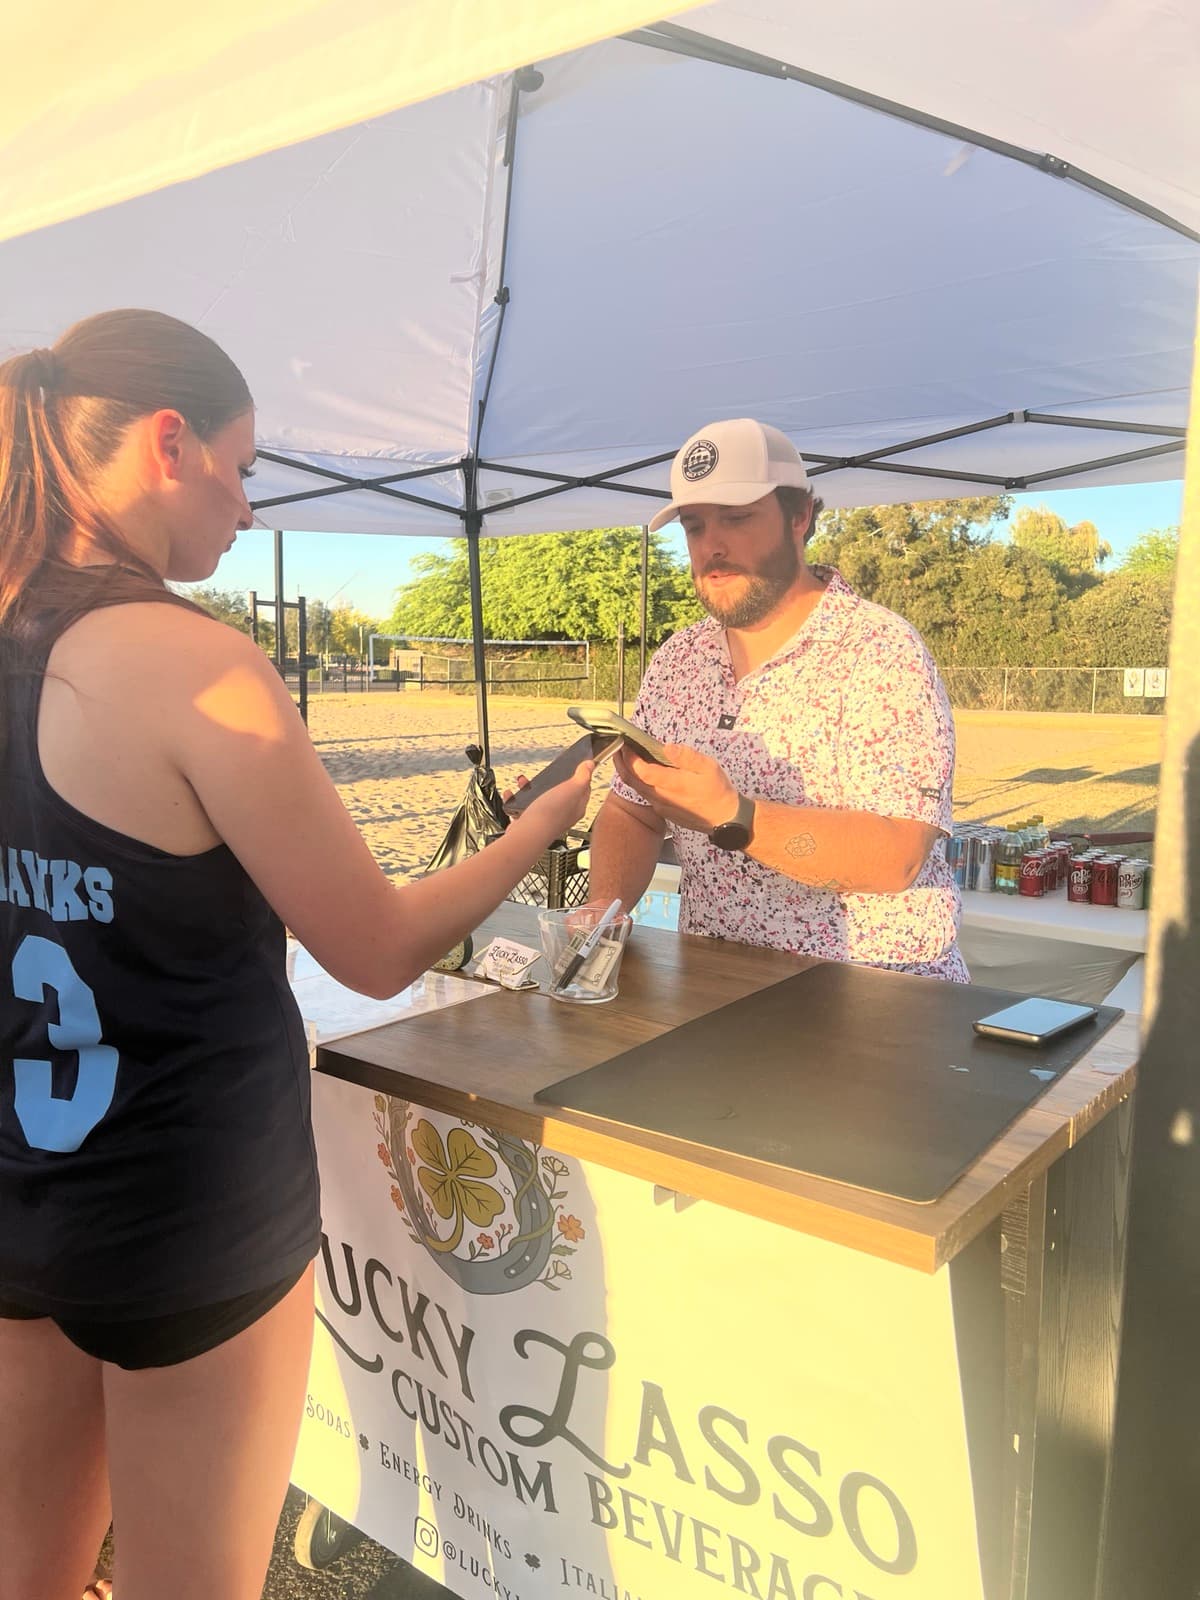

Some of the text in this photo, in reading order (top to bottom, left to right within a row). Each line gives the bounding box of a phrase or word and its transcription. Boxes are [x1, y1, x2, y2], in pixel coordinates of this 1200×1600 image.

[0, 845, 114, 924] AWKS
[12, 934, 119, 1153] 3
[306, 1394, 351, 1438] SODAS
[379, 1441, 443, 1502] ENERGY
[453, 1492, 513, 1560] DRINKS
[314, 1232, 919, 1577] UCKY LASSO
[391, 1368, 560, 1515] CUSTOM
[442, 1540, 520, 1600] @LUCKY
